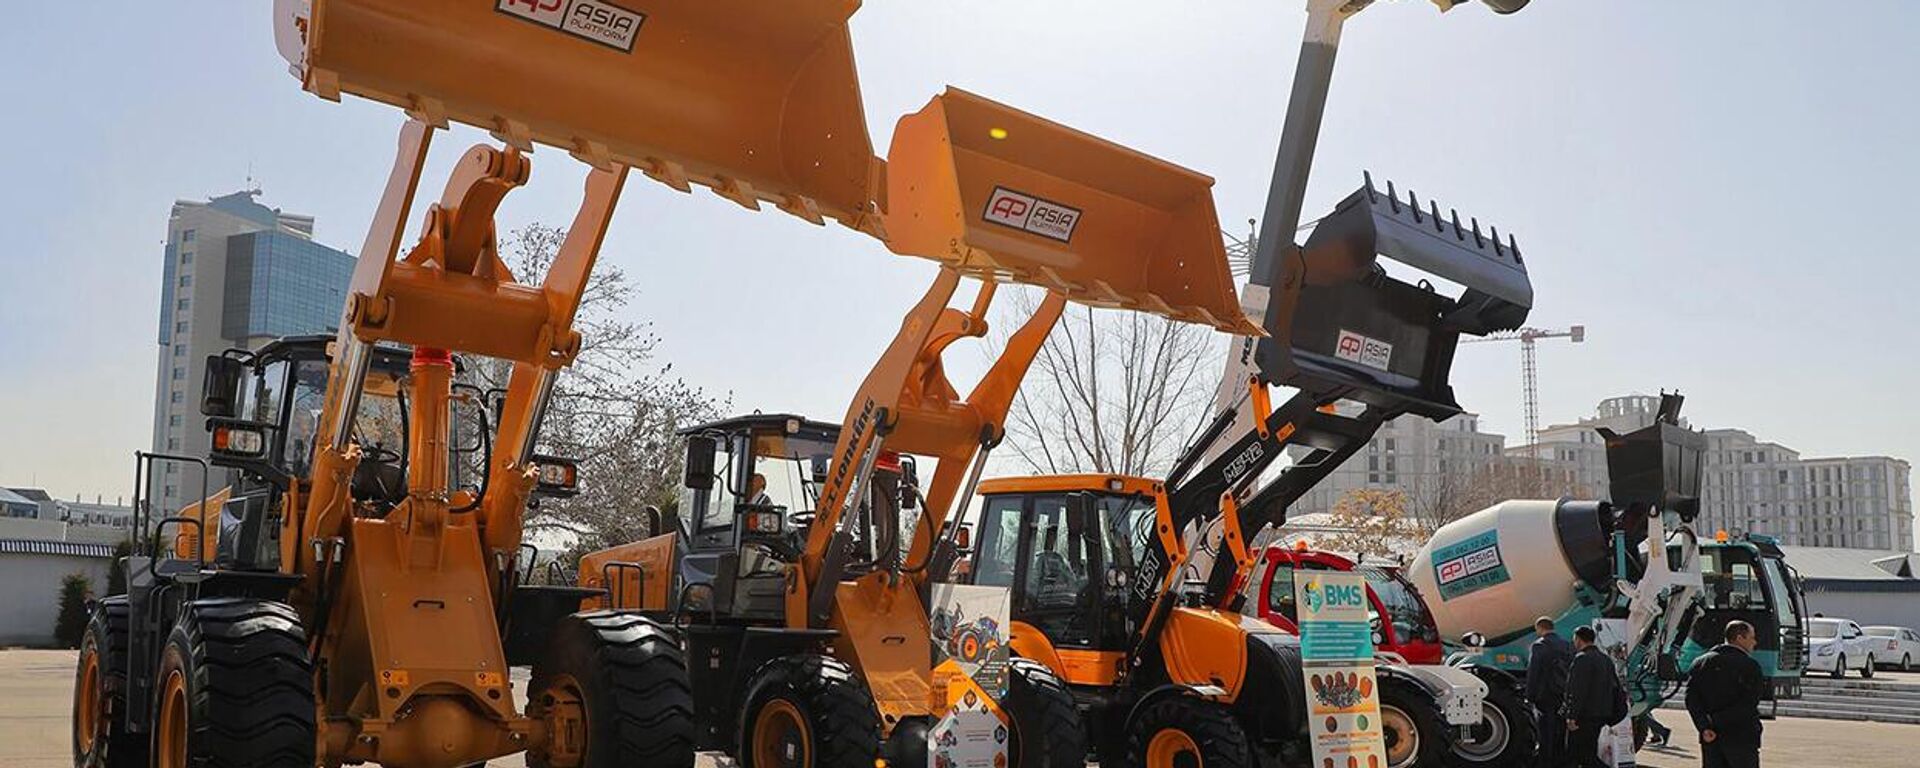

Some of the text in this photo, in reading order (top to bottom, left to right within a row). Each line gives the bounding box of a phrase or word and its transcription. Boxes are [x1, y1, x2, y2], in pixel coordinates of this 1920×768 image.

[570, 18, 628, 42] PLATFORM
[574, 3, 633, 33] ASIA
[991, 196, 1074, 227] AP ASIA
[1339, 336, 1360, 355] AP
[1134, 549, 1160, 600] MST
[1440, 549, 1495, 580] AP ASIA
[1324, 584, 1363, 606] BMS
